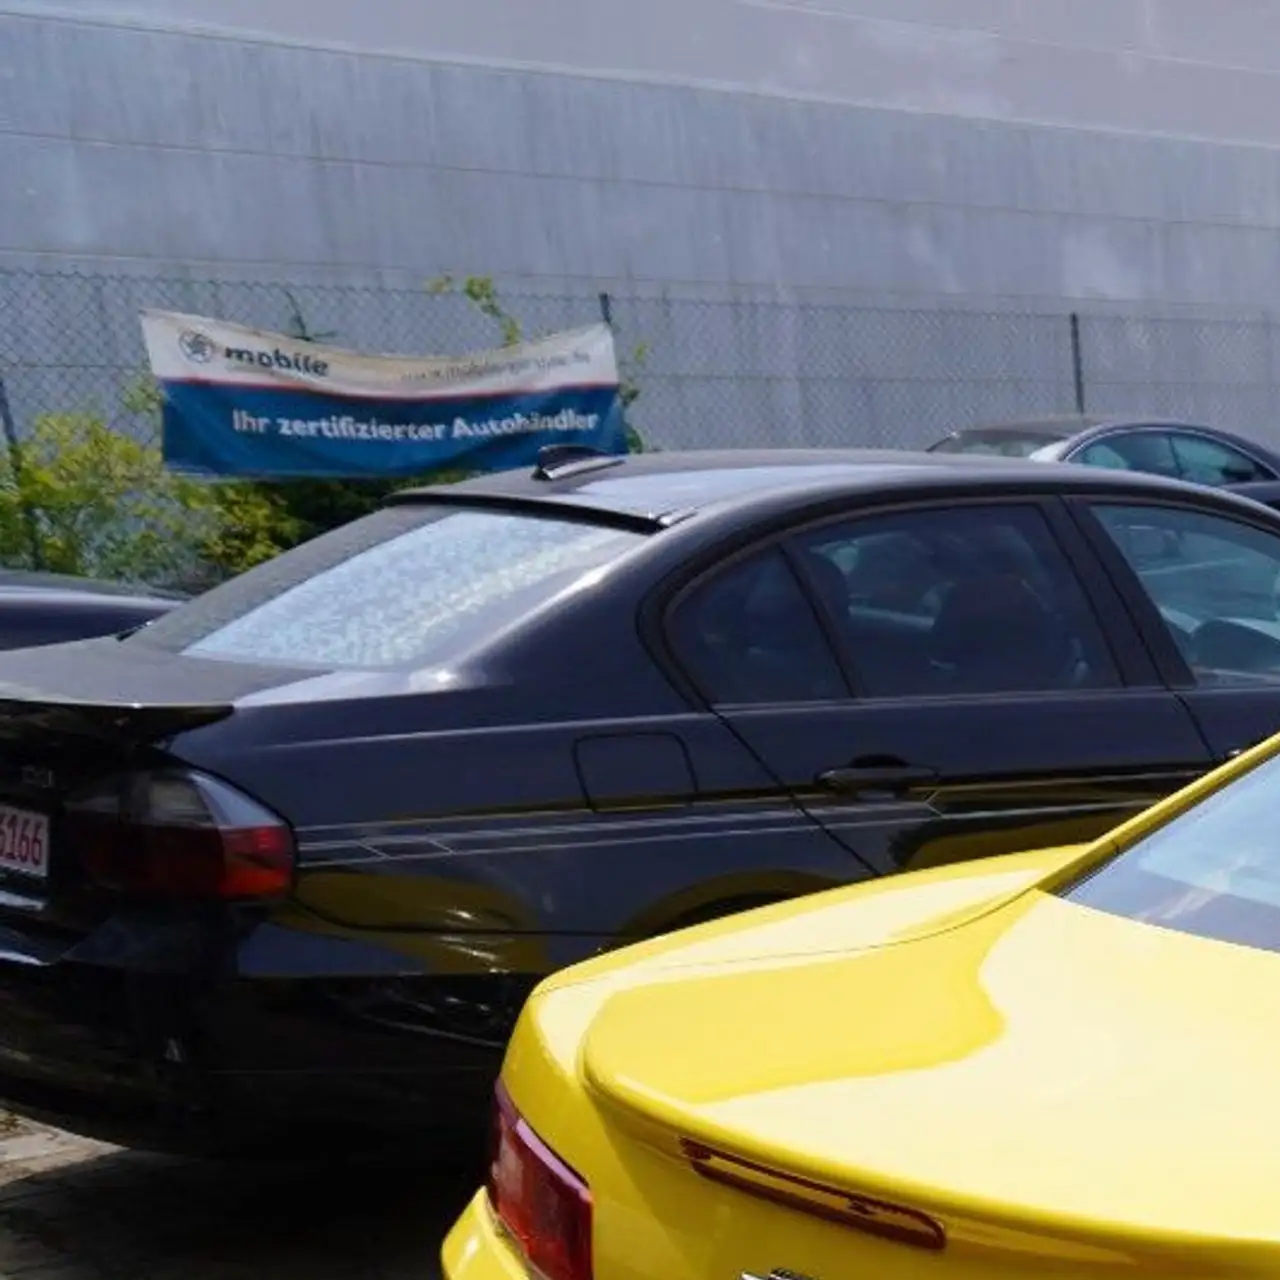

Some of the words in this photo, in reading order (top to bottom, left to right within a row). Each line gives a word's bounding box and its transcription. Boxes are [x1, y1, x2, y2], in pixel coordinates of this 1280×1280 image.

[225, 346, 329, 377] mobile
[233, 408, 272, 434] Ihr
[276, 414, 445, 440] zertifizierter
[451, 408, 598, 438] Autohändler
